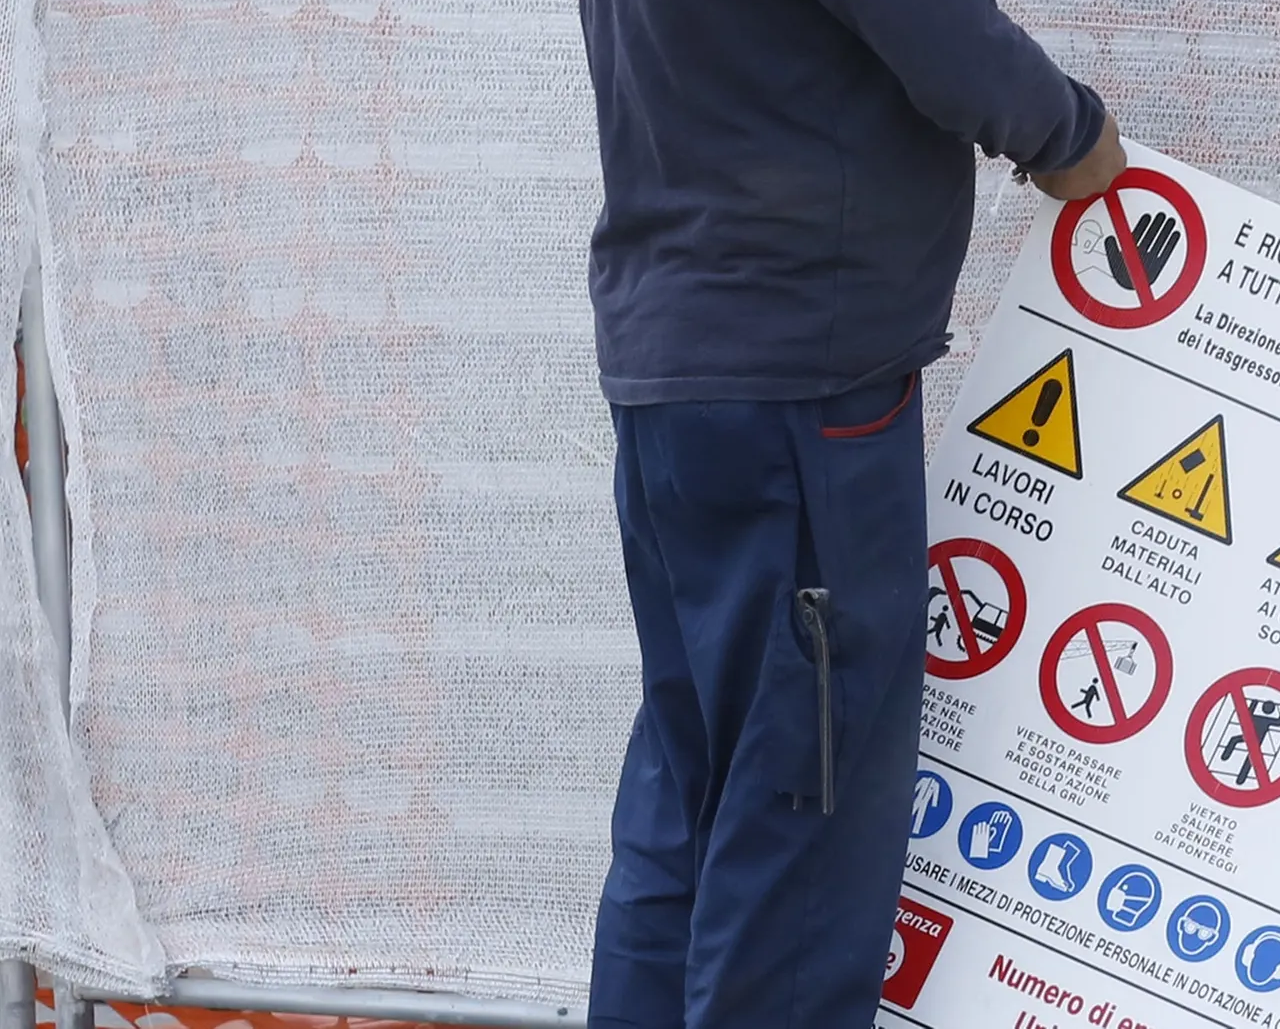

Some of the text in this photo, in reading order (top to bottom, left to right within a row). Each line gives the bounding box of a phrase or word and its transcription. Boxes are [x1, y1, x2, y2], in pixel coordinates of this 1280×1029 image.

[1217, 260, 1233, 283] A
[1195, 304, 1213, 324] La
[1178, 329, 1203, 349] dei
[972, 453, 1054, 504] LAVORI
[944, 479, 1053, 541] IN CORSO
[1132, 521, 1198, 560] CADUTA
[1102, 556, 1191, 604] DALL'ALTO
[1111, 536, 1201, 585] MATERIALI
[1258, 602, 1276, 617] AI
[920, 712, 966, 739] AZIONE
[940, 707, 961, 724] NEL
[1017, 726, 1122, 779] VIETATO PASSARE
[1018, 741, 1106, 788] E SOSTARE NEL
[1005, 750, 1110, 803] RAGGIO D'AZIONE
[1019, 771, 1085, 806] DELLA GRU
[1181, 814, 1234, 843] SALIRE E
[1190, 803, 1237, 830] VIETATO
[1154, 831, 1237, 873] DAI PONTEGGI
[1170, 823, 1233, 857] SCENDERE
[904, 852, 950, 884] USARE
[949, 873, 957, 887] I
[956, 876, 997, 904] MEZZI
[997, 894, 1013, 911] DI
[1012, 901, 1095, 948] PROTEZIONE
[1094, 938, 1173, 983] PERSONALE
[1172, 972, 1189, 990] IN
[1188, 979, 1263, 1022] DOTAZIONE
[1261, 1013, 1272, 1028] A
[989, 955, 1083, 1014] Numero
[1089, 1002, 1116, 1029] di
